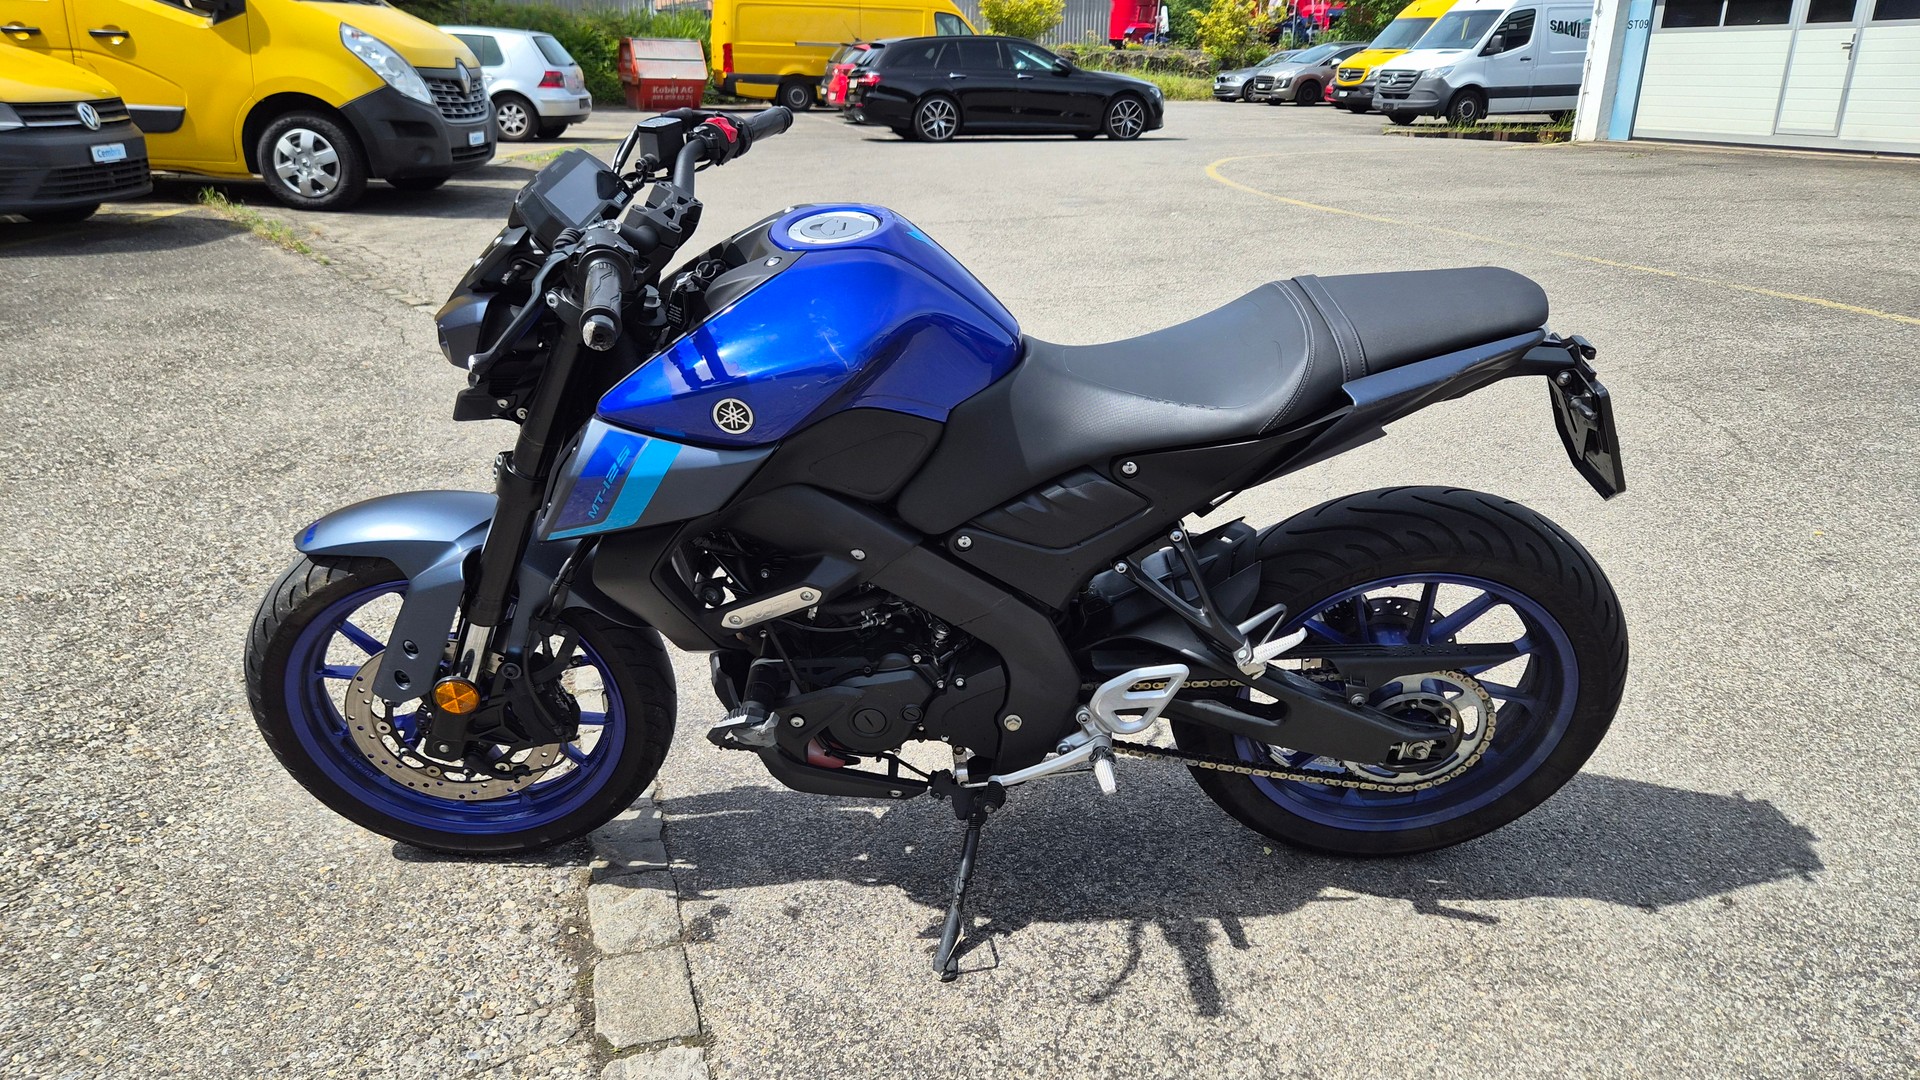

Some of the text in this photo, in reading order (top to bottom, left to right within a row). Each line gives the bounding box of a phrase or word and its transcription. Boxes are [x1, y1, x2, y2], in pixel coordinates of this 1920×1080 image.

[1550, 20, 1581, 38] SALVI
[1627, 19, 1649, 30] ST09
[680, 86, 694, 94] AG
[588, 445, 631, 519] MT-125
